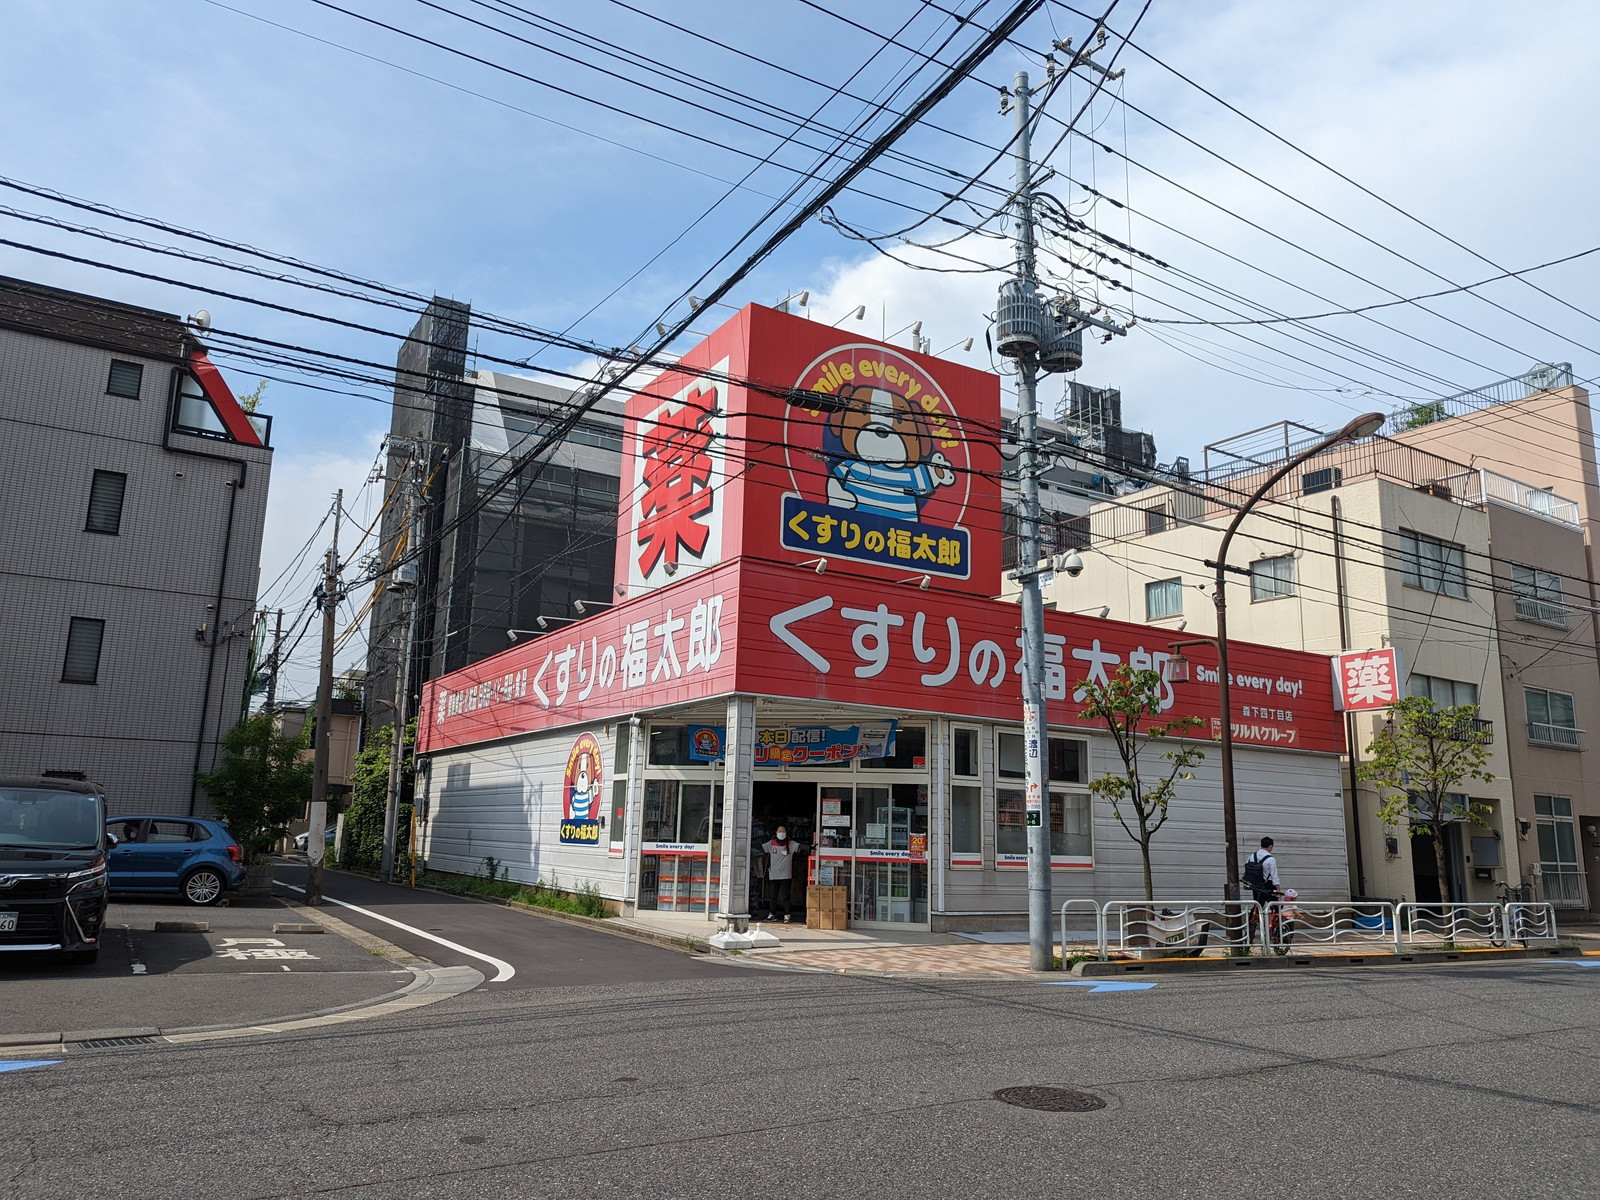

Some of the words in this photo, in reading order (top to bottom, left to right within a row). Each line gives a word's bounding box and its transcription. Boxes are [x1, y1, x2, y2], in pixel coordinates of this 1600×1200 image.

[802, 361, 856, 417] mile
[858, 359, 921, 399] every
[637, 386, 719, 580] 薬
[788, 510, 961, 567] くすりの福太郎
[533, 594, 724, 709] くすりの福太郎
[769, 595, 1175, 713] くすりの福太郎
[1345, 655, 1393, 704] 薬
[1196, 665, 1233, 685] Smie
[1237, 674, 1272, 695] every
[1276, 676, 1303, 698] day!
[1242, 705, 1293, 722] 森下四丁目店
[560, 824, 598, 840] くすりの福太郎
